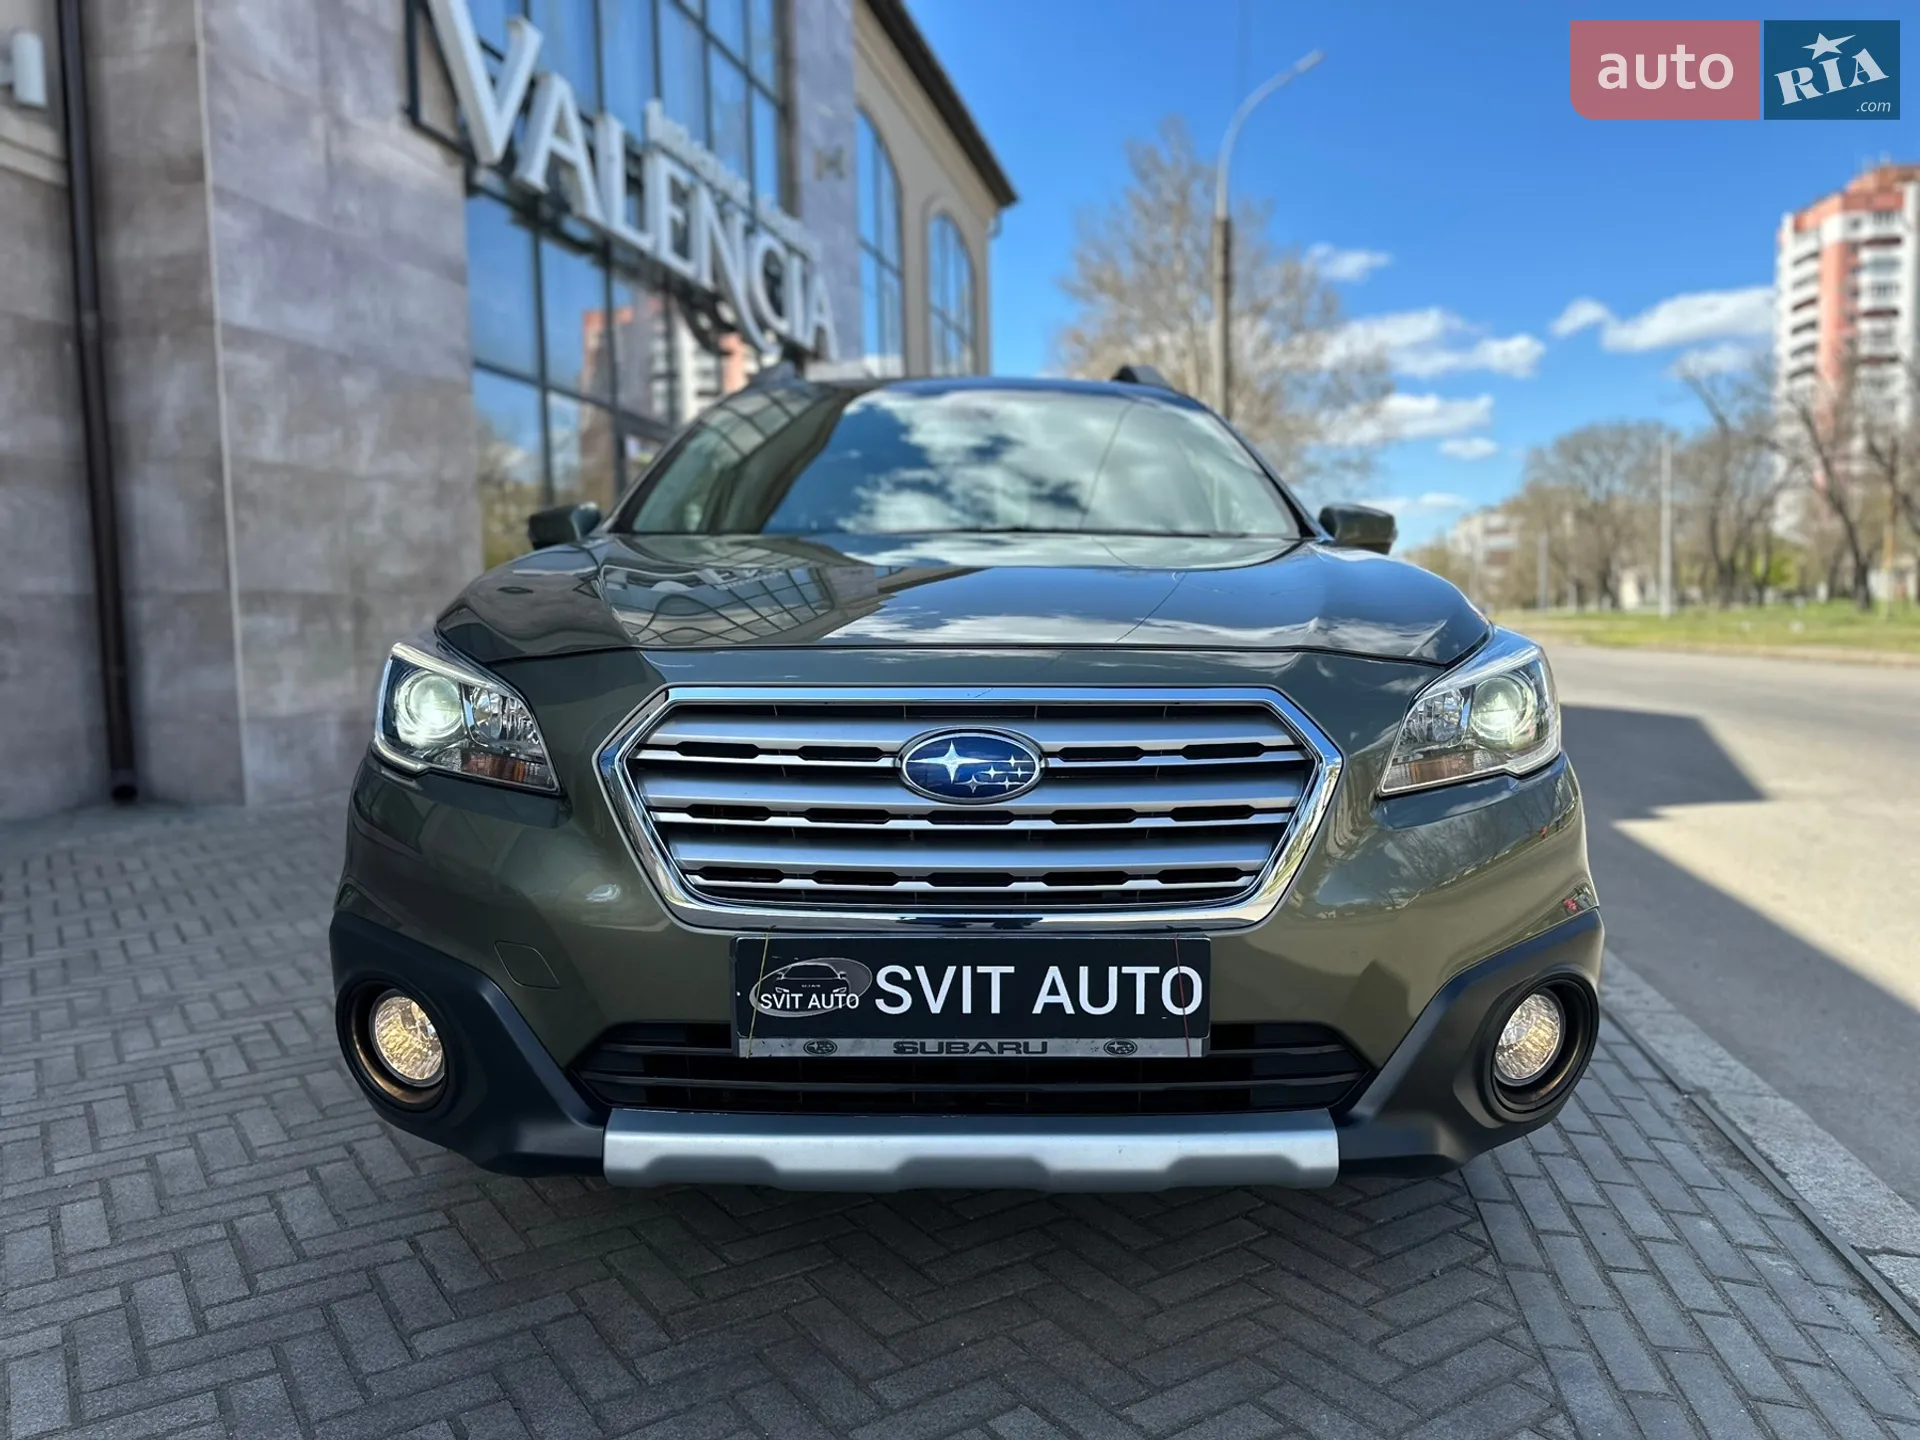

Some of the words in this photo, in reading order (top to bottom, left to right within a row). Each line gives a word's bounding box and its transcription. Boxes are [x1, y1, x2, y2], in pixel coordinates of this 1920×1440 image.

[428, 0, 839, 361] VALENCIA
[760, 993, 804, 1010] SVIT
[807, 993, 860, 1010] AUTO
[874, 965, 1015, 1015] SVIT
[1031, 965, 1203, 1016] AUTO
[892, 1041, 1049, 1056] SUBARU
